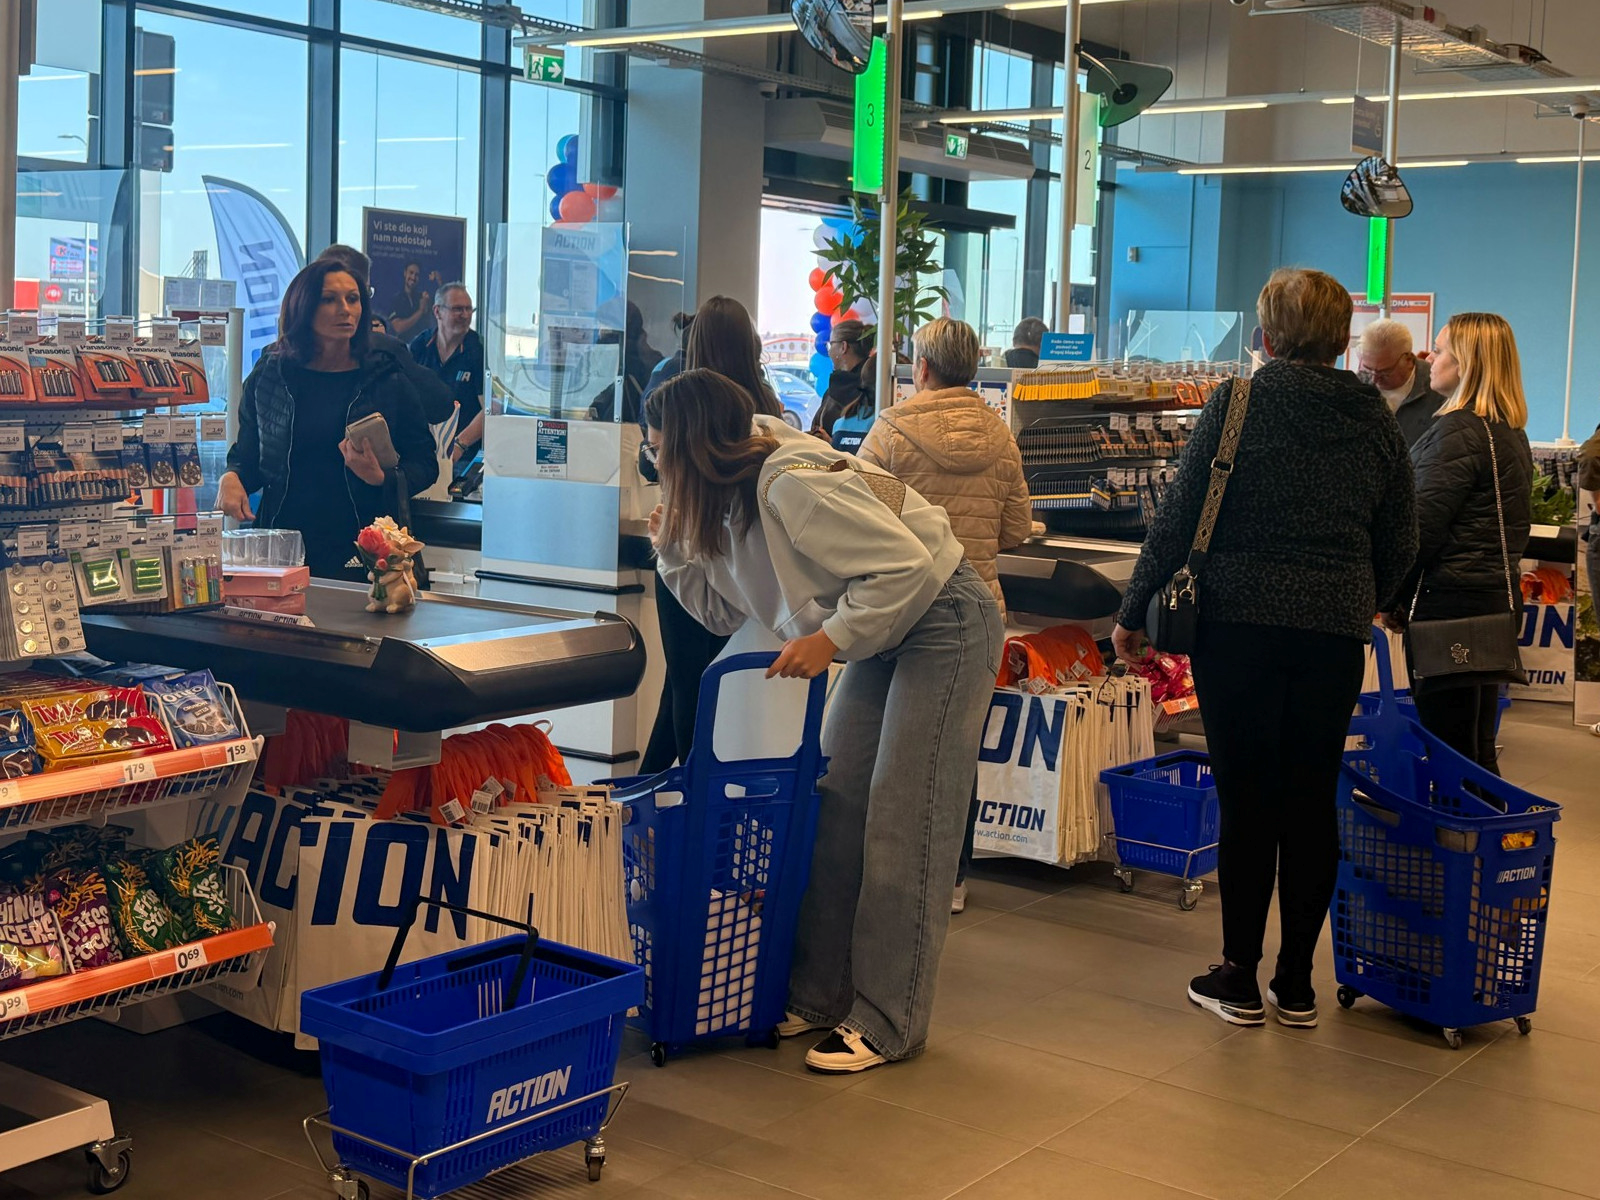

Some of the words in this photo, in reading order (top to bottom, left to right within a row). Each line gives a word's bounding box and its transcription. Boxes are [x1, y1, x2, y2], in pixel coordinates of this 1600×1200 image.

[866, 103, 875, 127] 3
[1084, 149, 1092, 170] 2
[373, 220, 383, 230] Vi
[384, 222, 397, 232] ste
[399, 223, 412, 233] dio
[413, 224, 428, 237] koji
[373, 233, 391, 242] nam
[393, 235, 432, 248] nedostaje
[554, 233, 596, 251] ACTION
[28, 347, 71, 356] Panasonic
[127, 346, 167, 354] Panasonic
[169, 349, 201, 358] anasonic
[1524, 669, 1566, 685] TION
[1500, 866, 1536, 883] ACTION
[485, 1064, 572, 1124] ACTION
